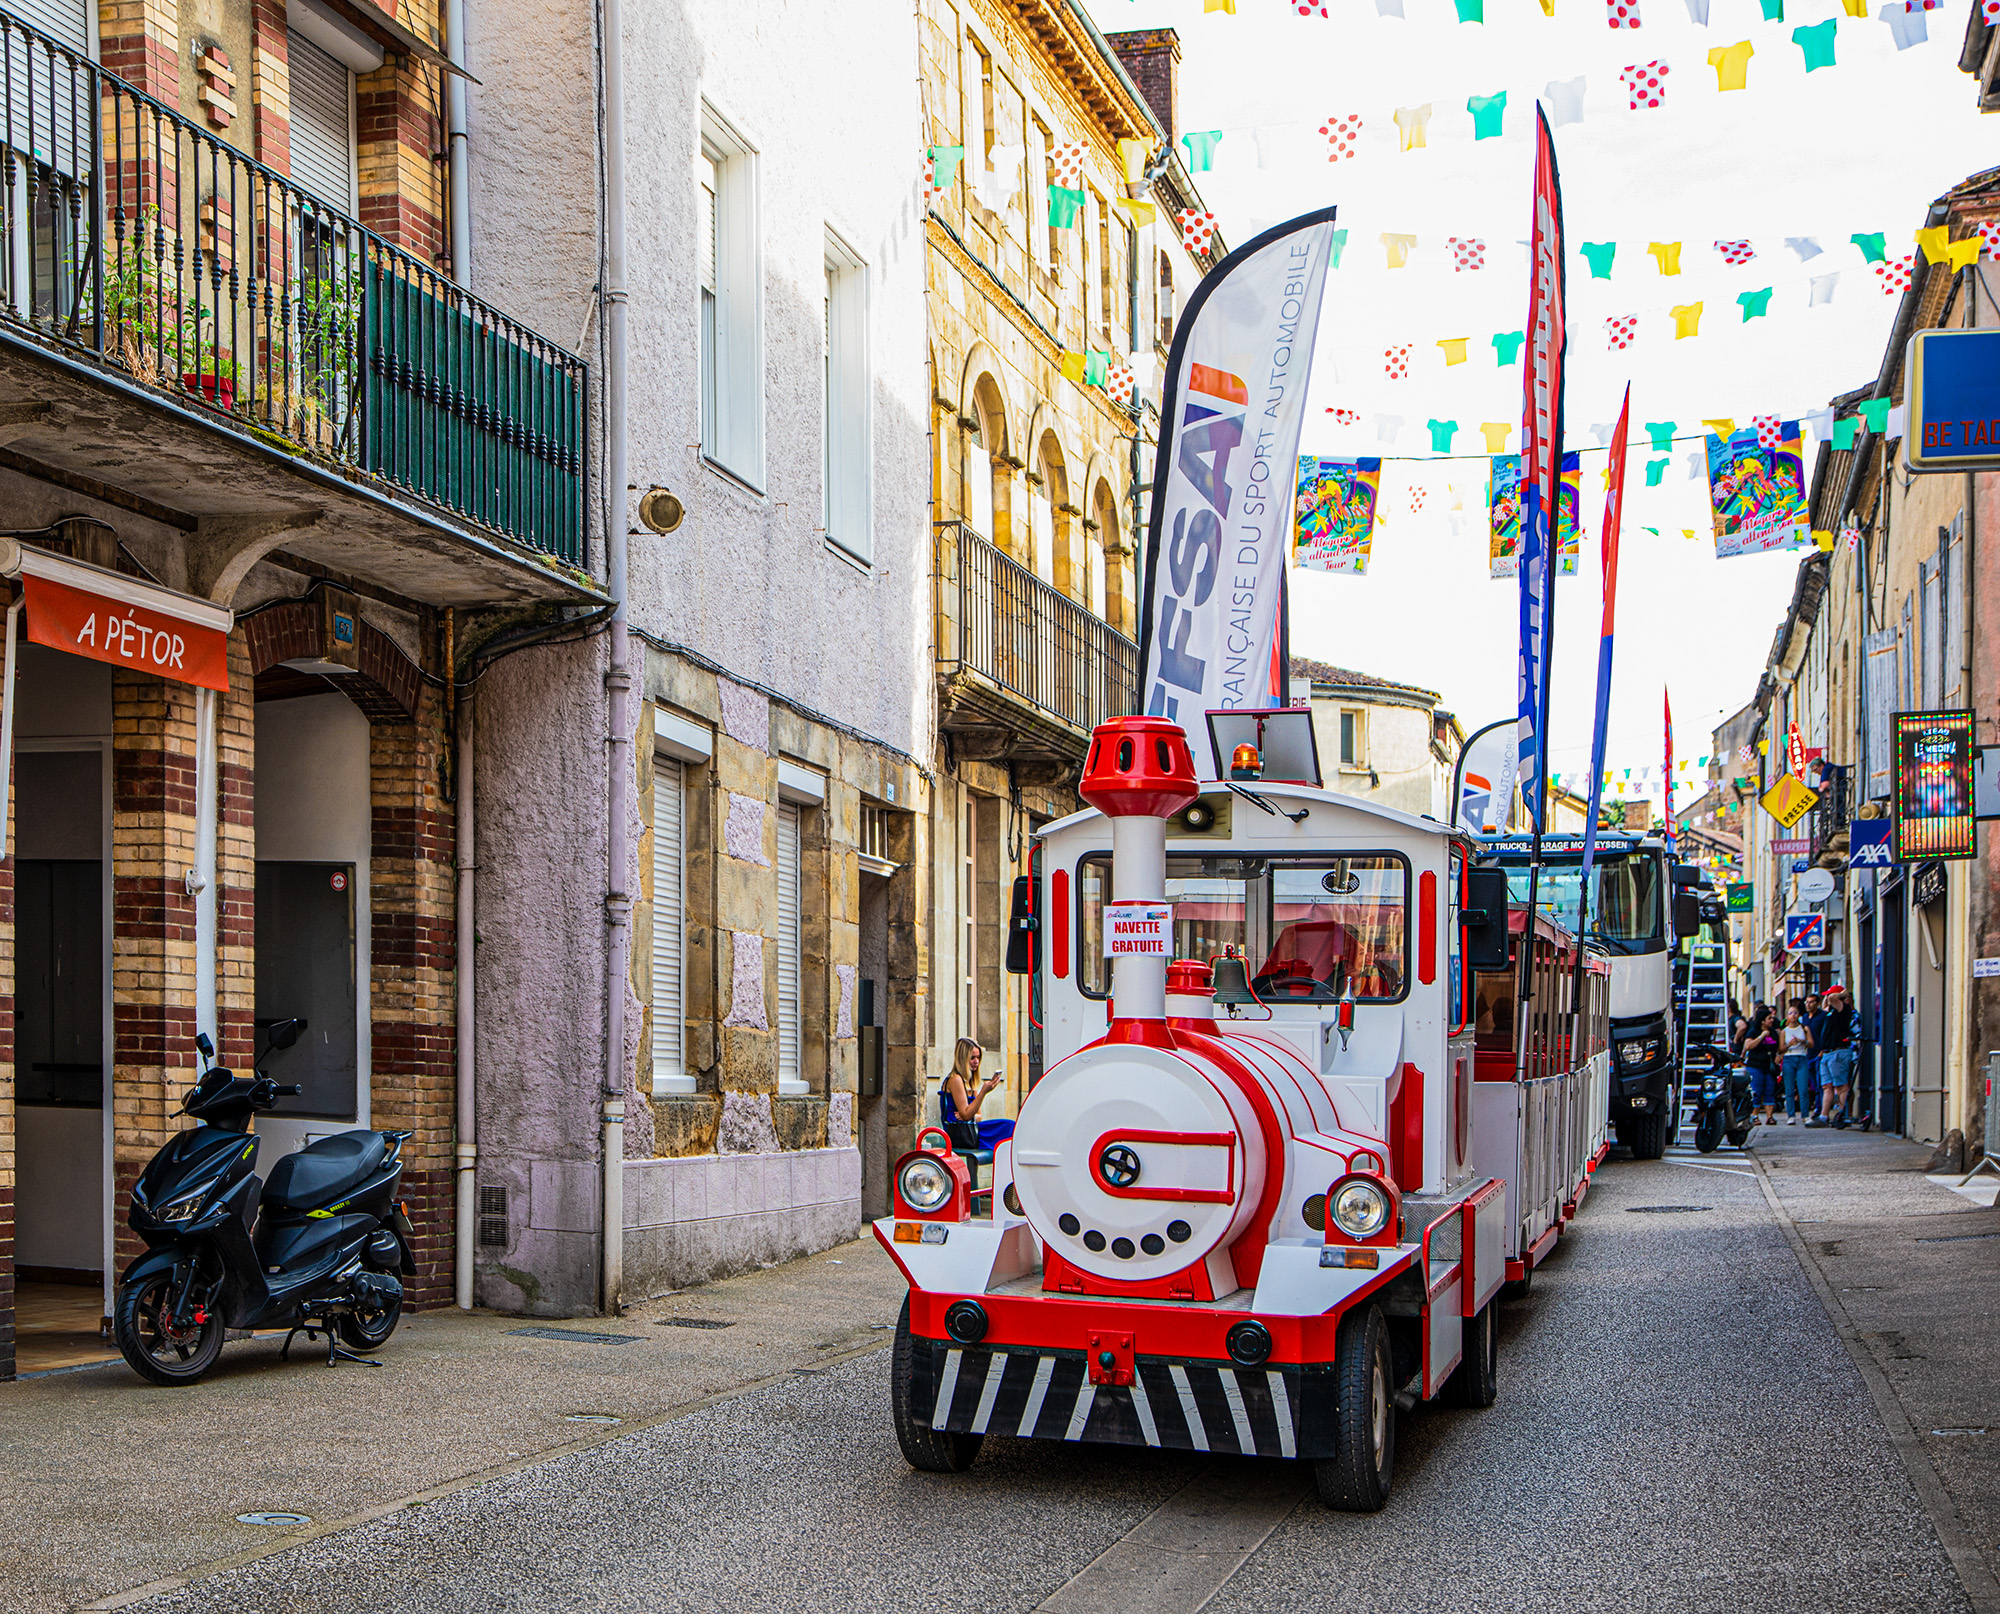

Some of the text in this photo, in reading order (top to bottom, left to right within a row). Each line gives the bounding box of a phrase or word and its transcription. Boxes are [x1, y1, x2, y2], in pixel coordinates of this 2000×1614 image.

[1264, 243, 1310, 417] AUTOMOBILE
[1924, 421, 1952, 448] BE
[1243, 428, 1275, 516] SPORT
[1741, 510, 1786, 530] Nogaro
[1777, 518, 1795, 531] son
[1238, 526, 1261, 564] DU
[1342, 546, 1358, 557] son
[1760, 535, 1784, 551] Tour
[1148, 412, 1246, 722] FSA
[1324, 560, 1347, 571] Tour
[77, 609, 185, 669] A PÉTOR
[339, 621, 350, 637] 57
[1221, 576, 1257, 709] RANÇAISE
[1499, 728, 1518, 800] AUTOMOBILE
[1783, 794, 1813, 824] PRESSE
[1495, 842, 1527, 850] TRUCKS
[1541, 841, 1569, 849] ARAGE
[1571, 841, 1628, 850] MOEYSSEN
[1851, 844, 1892, 864] AXA
[1114, 921, 1160, 934] NAVETTE
[1111, 940, 1164, 953] GRATUITE
